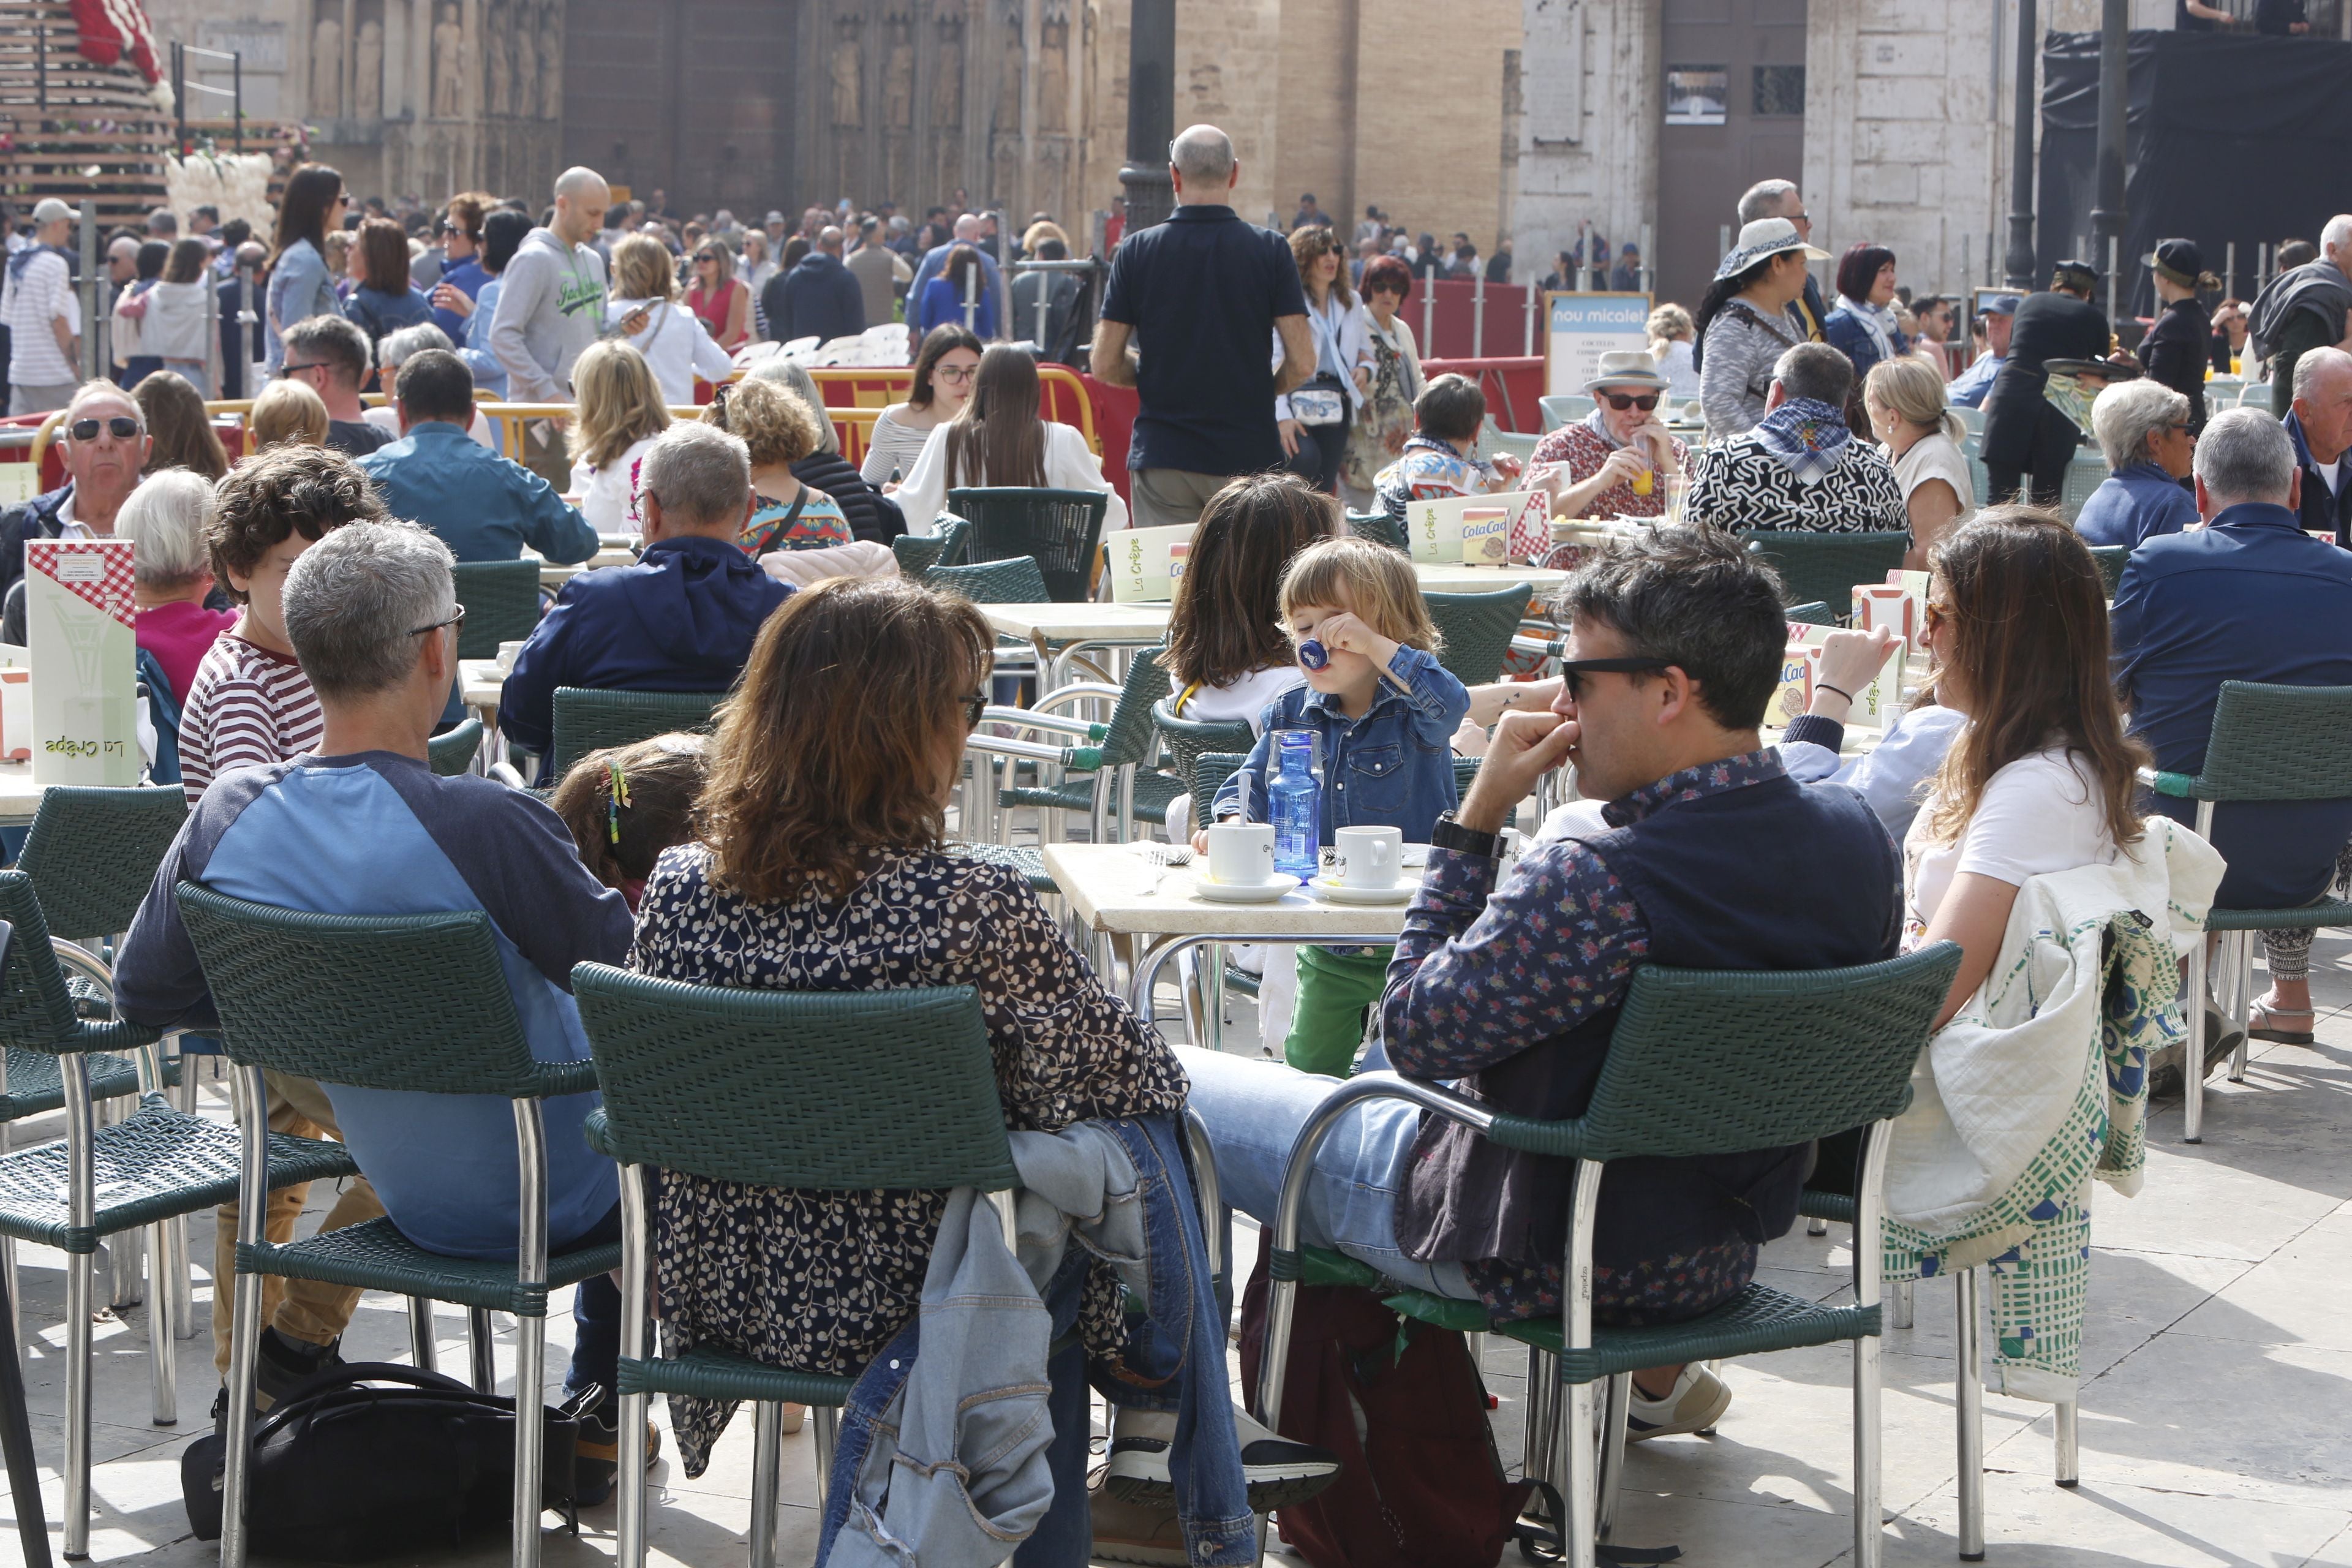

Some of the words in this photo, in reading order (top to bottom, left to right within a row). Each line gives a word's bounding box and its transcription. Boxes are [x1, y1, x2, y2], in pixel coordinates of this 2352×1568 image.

[1554, 310, 1583, 323] nou
[1587, 308, 1645, 323] micalet
[1462, 520, 1507, 539] ColaCao
[1129, 538, 1144, 575] Crêpe
[1133, 578, 1144, 592] La
[1866, 676, 1880, 716] rêpe
[45, 735, 99, 758] Crêpe
[104, 741, 124, 758] La
